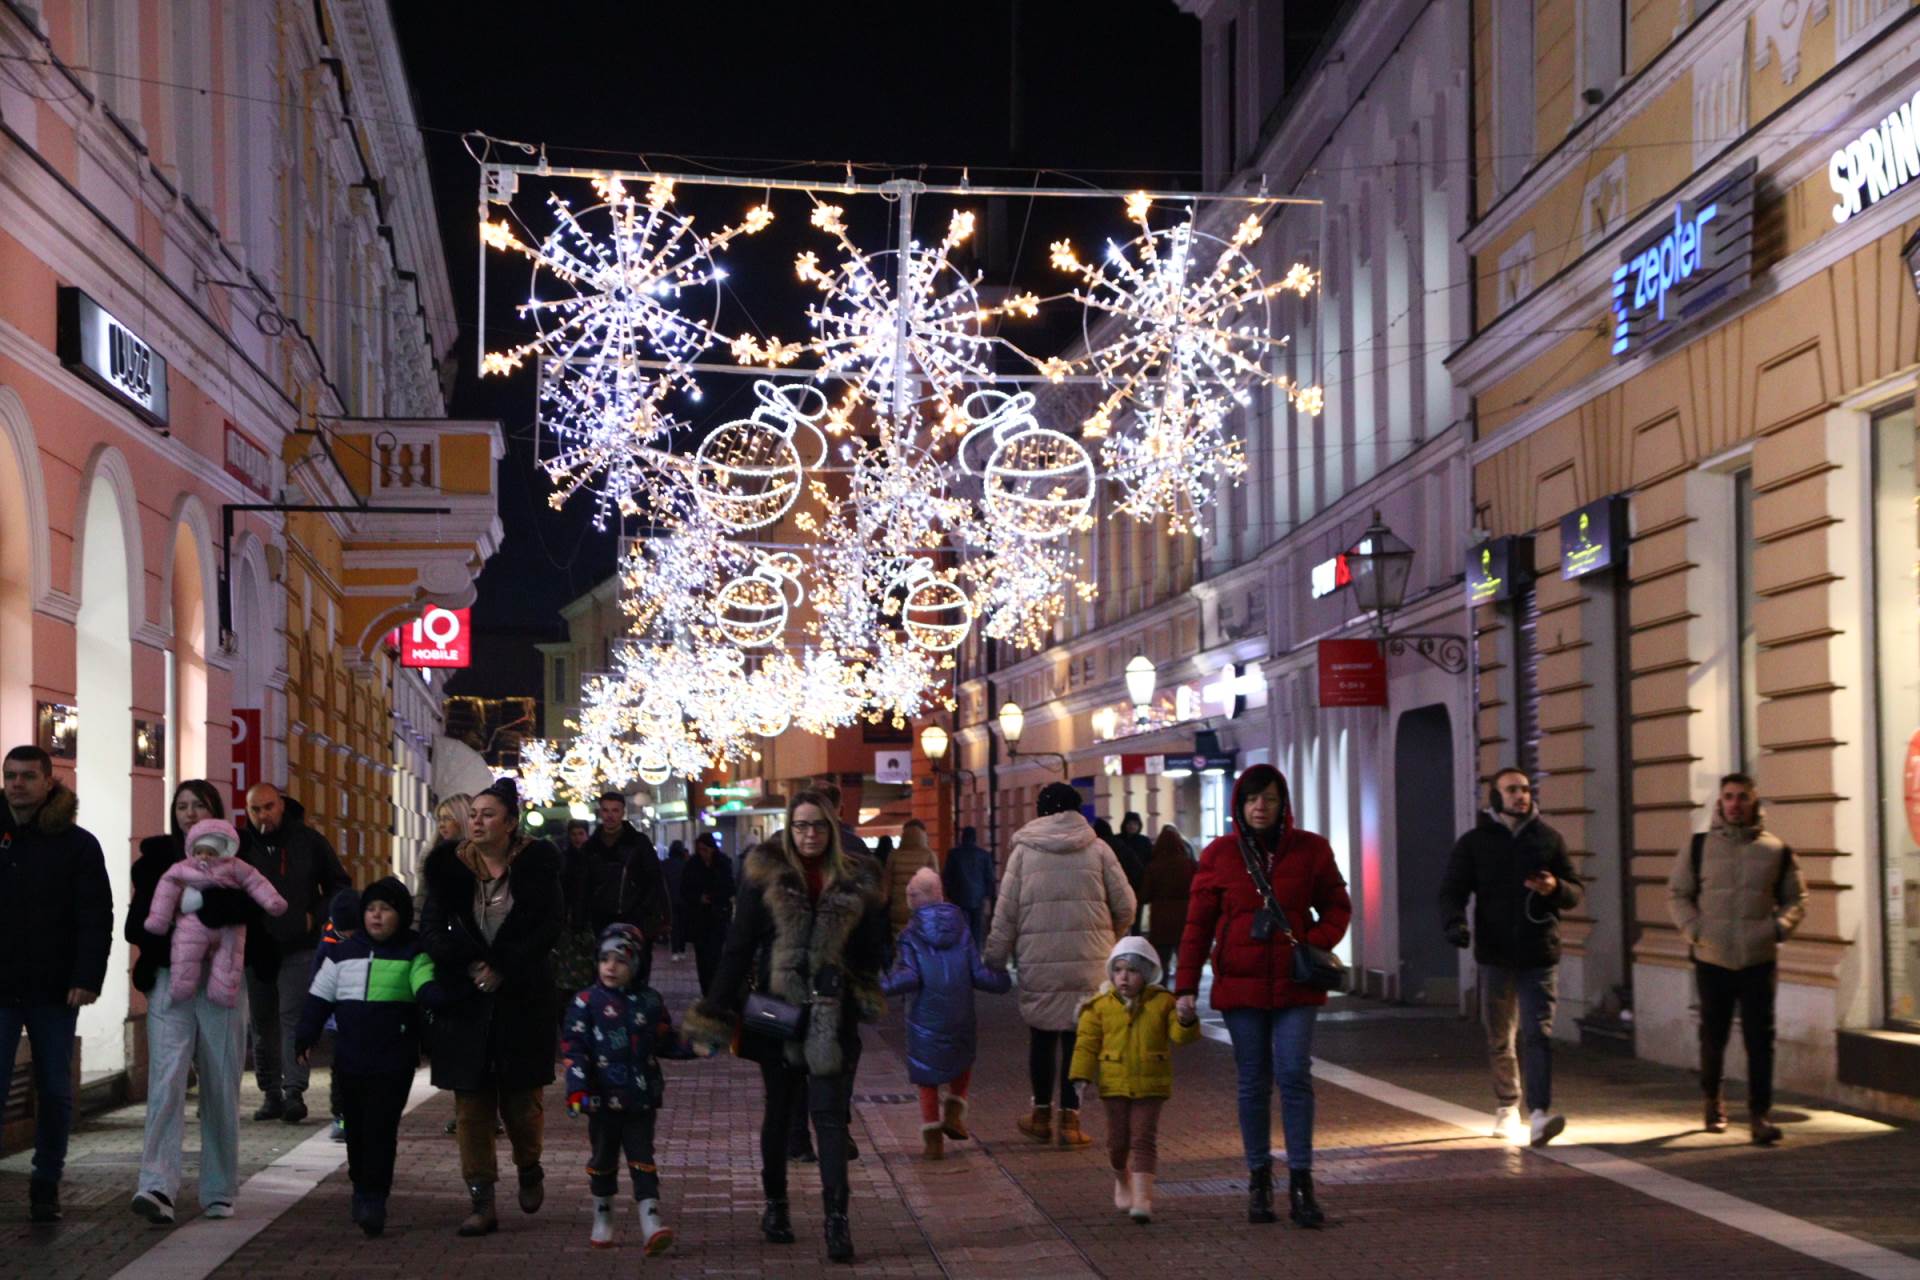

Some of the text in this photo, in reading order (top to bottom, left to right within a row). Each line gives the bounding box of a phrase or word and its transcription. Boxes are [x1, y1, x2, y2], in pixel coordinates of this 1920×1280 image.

[1628, 202, 1717, 321] zepter
[412, 607, 460, 650] IQ
[411, 648, 459, 661] MOBILE
